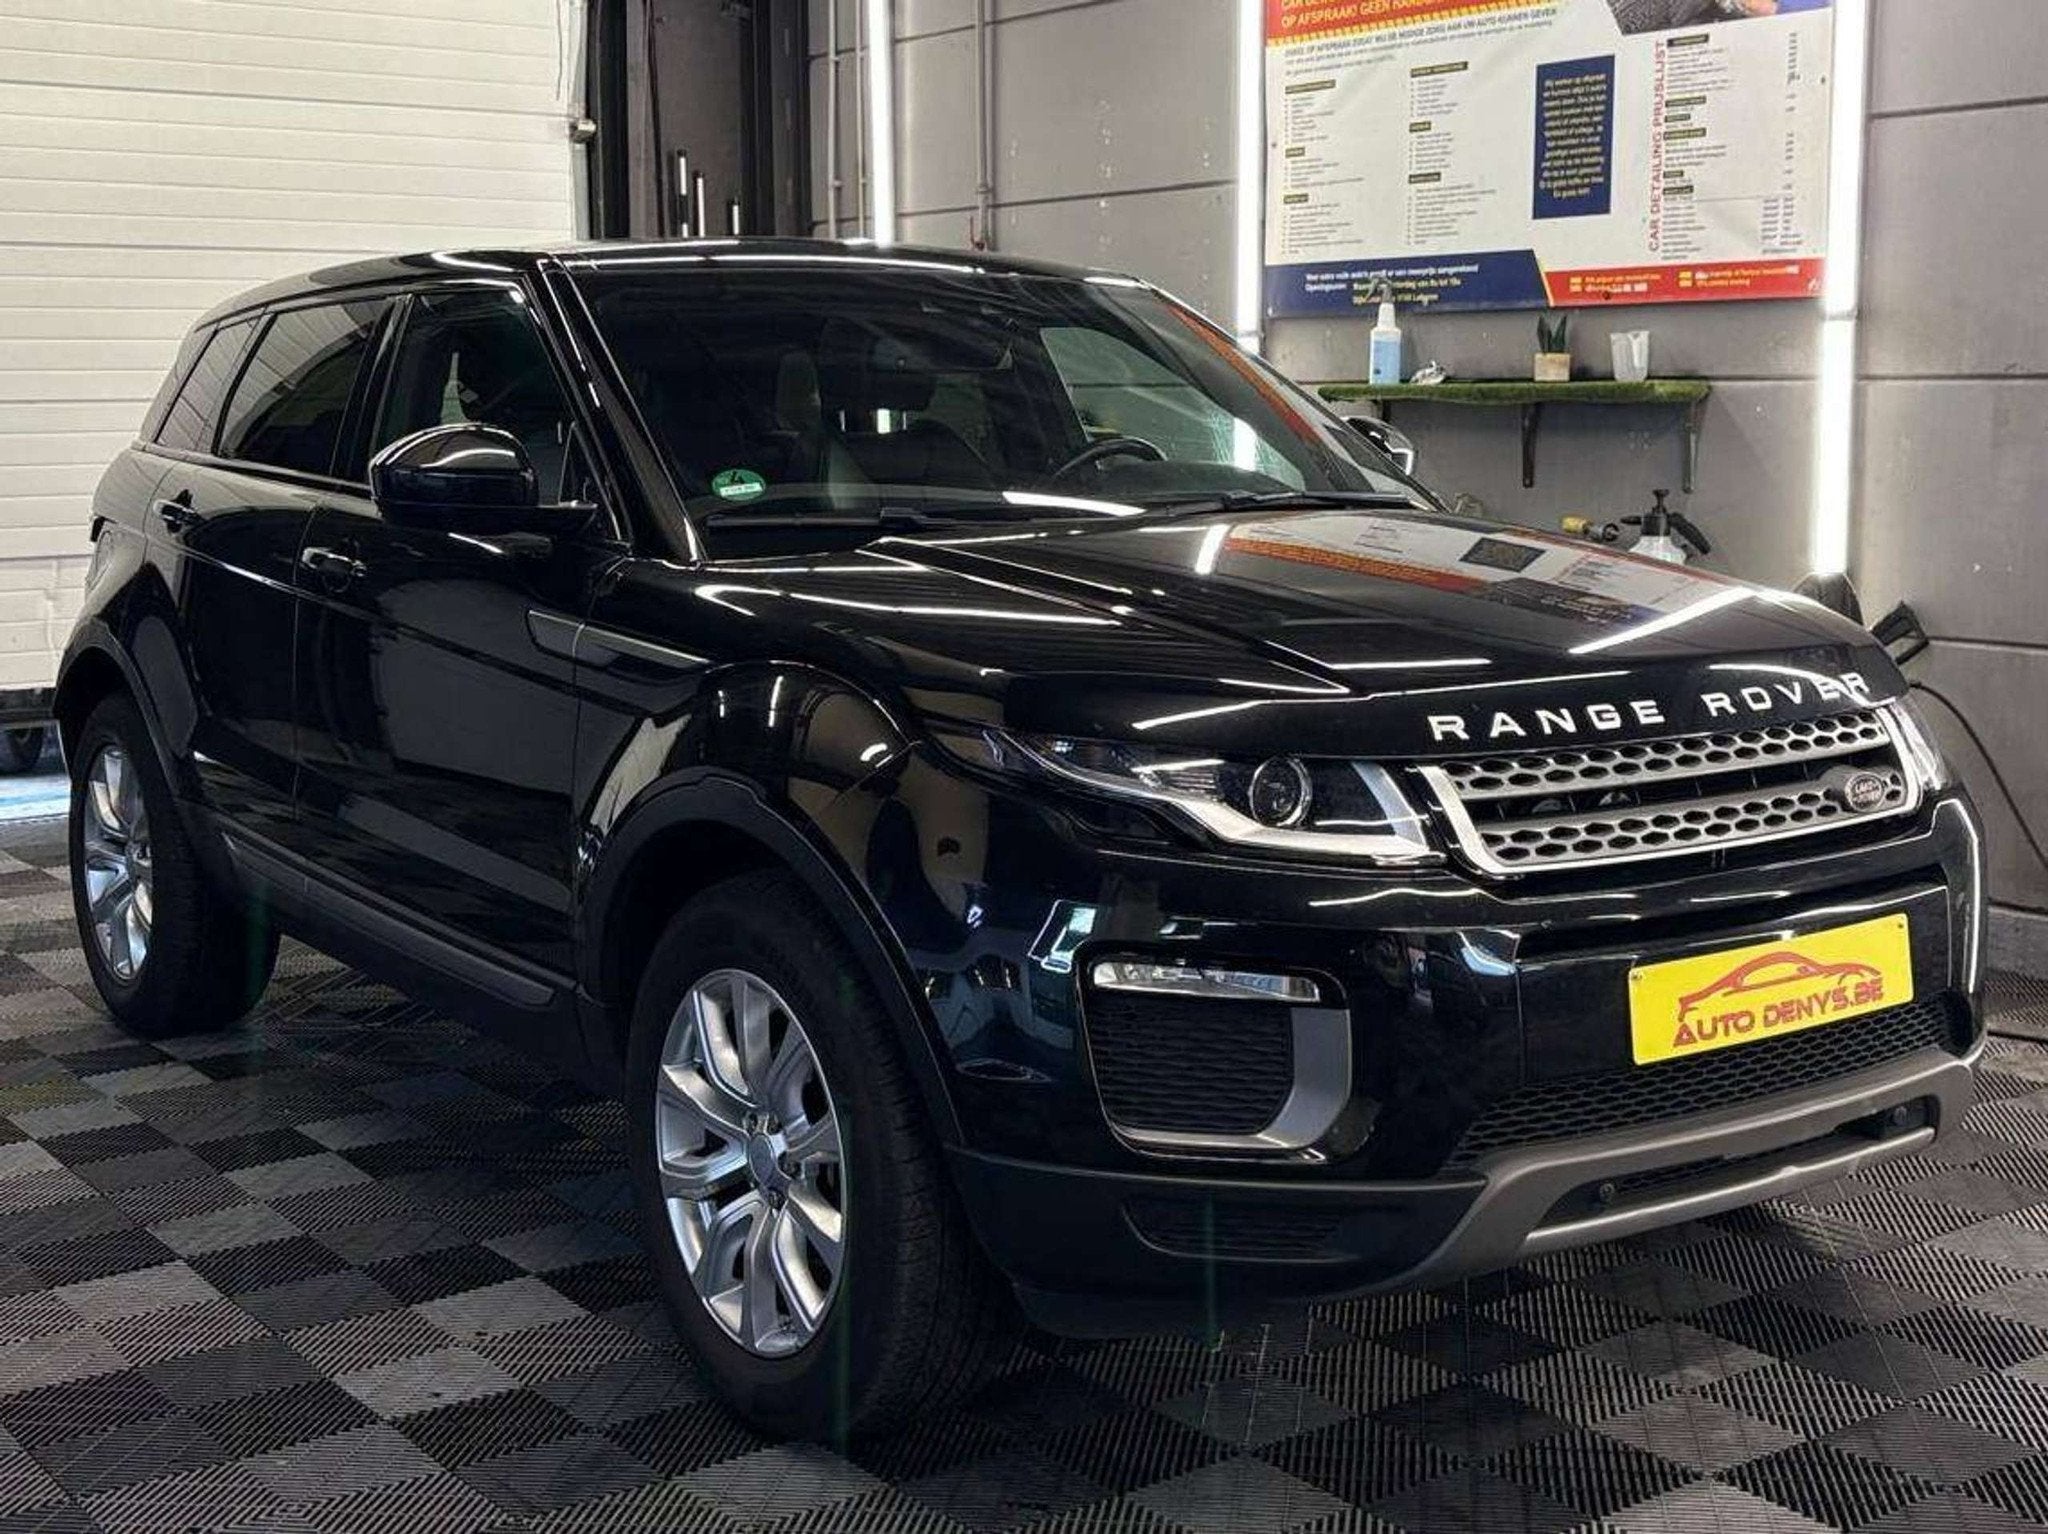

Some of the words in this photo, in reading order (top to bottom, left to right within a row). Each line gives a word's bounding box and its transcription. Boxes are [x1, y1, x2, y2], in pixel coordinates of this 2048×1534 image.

[1281, 14, 1297, 28] OP
[1650, 132, 1663, 214] DETAILING
[1649, 217, 1661, 252] CAR
[1427, 699, 1666, 741] RANGE
[1701, 672, 1870, 717] ROVER
[1673, 1010, 1755, 1047] AUTO
[1763, 977, 1884, 1027] DENYS.BE
